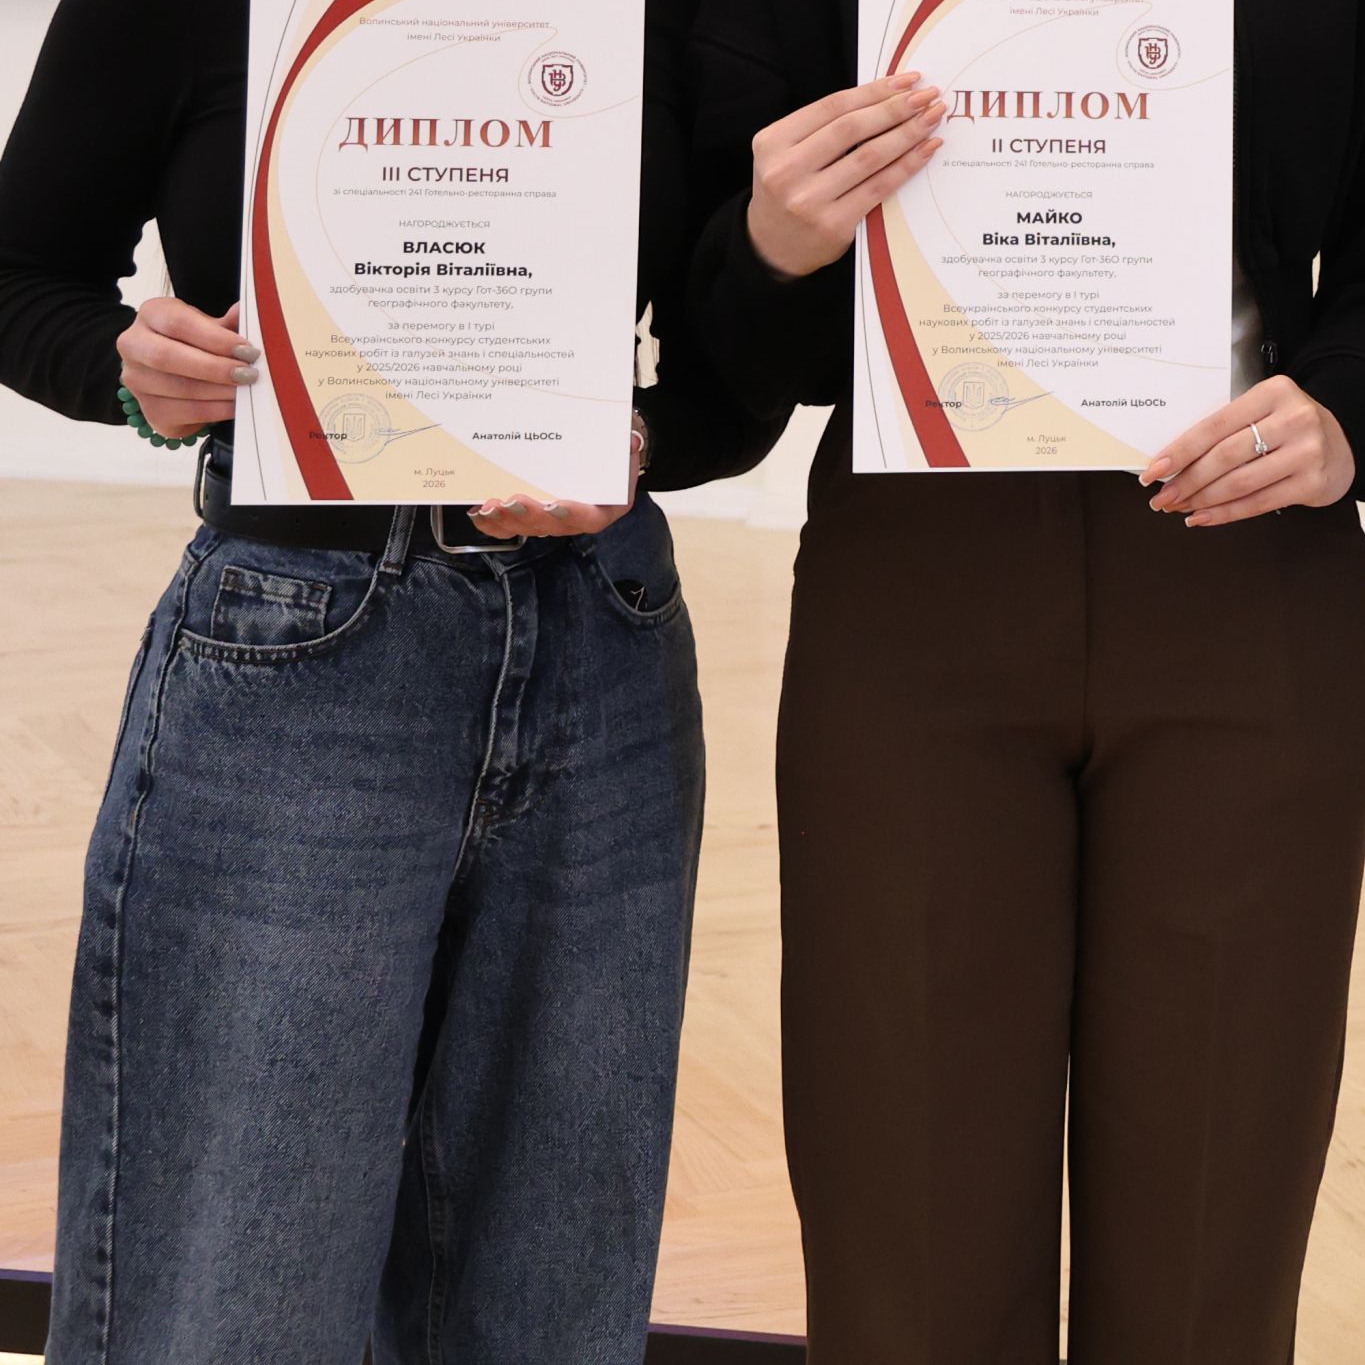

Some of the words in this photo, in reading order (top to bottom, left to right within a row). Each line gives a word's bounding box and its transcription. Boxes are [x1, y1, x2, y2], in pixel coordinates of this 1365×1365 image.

[945, 89, 1149, 124] ДИПЛОМ
[337, 115, 553, 152] ДИПЛОМ
[1008, 138, 1106, 154] СТУПЕНЯ
[406, 166, 509, 183] СТУПЕНЯ
[1016, 208, 1083, 225] МАЙКО
[982, 231, 1019, 246] Віка
[1023, 231, 1116, 248] Віталіївна,
[402, 240, 487, 255] ВЛАСЮК
[940, 253, 1002, 265] здобувачка
[1003, 253, 1037, 264] освіти
[1038, 254, 1046, 264] 3
[1047, 256, 1079, 266] курсу
[1121, 256, 1153, 266] групи
[353, 260, 430, 279] Вікторія
[435, 261, 533, 279] Віталіївна,
[977, 267, 1055, 279] географічного
[328, 283, 393, 295] здобувачка
[395, 284, 430, 294] освіти
[431, 284, 440, 294] 3
[441, 286, 474, 296] курсу
[519, 287, 553, 297] групи
[996, 291, 1009, 299] за
[1011, 291, 1063, 301] перемогу
[1064, 291, 1071, 299] в
[1077, 289, 1099, 301] турі
[367, 298, 448, 310] географічного
[943, 303, 1031, 315] Всеукраїнського
[1032, 305, 1082, 315] конкурсу
[1083, 305, 1154, 315] студентських
[386, 322, 400, 330] за
[401, 322, 457, 332] перемогу
[458, 322, 465, 330] в
[472, 320, 495, 332] турі
[330, 334, 423, 346] Всеукраїнського
[424, 336, 476, 346] конкурсу
[477, 336, 551, 346] студентських
[304, 349, 357, 359] наукових
[358, 347, 389, 359] робіт
[390, 348, 399, 358] із
[401, 348, 445, 360] галузей
[446, 350, 481, 358] знань
[487, 348, 576, 359] спеціальностей
[355, 363, 364, 373] у
[364, 360, 420, 372] 2025/2026
[421, 364, 496, 374] навчальному
[497, 362, 522, 374] році
[996, 357, 1024, 367] імені
[1025, 357, 1049, 367] Лесі
[1050, 358, 1099, 369] Українки
[317, 377, 326, 387] у
[327, 375, 403, 387] Волинському
[404, 376, 489, 388] національному
[489, 376, 560, 388] університеті
[384, 389, 413, 399] імені
[414, 390, 440, 400] Лесі
[441, 390, 492, 402] Українки
[1079, 397, 1128, 407] Анатолій
[1129, 397, 1167, 408] ЦЬОСЬ
[470, 430, 521, 440] Анатолій
[523, 431, 563, 442] ЦЬОСЬ
[424, 467, 456, 477] Луцьк
[421, 479, 446, 488] 2026
